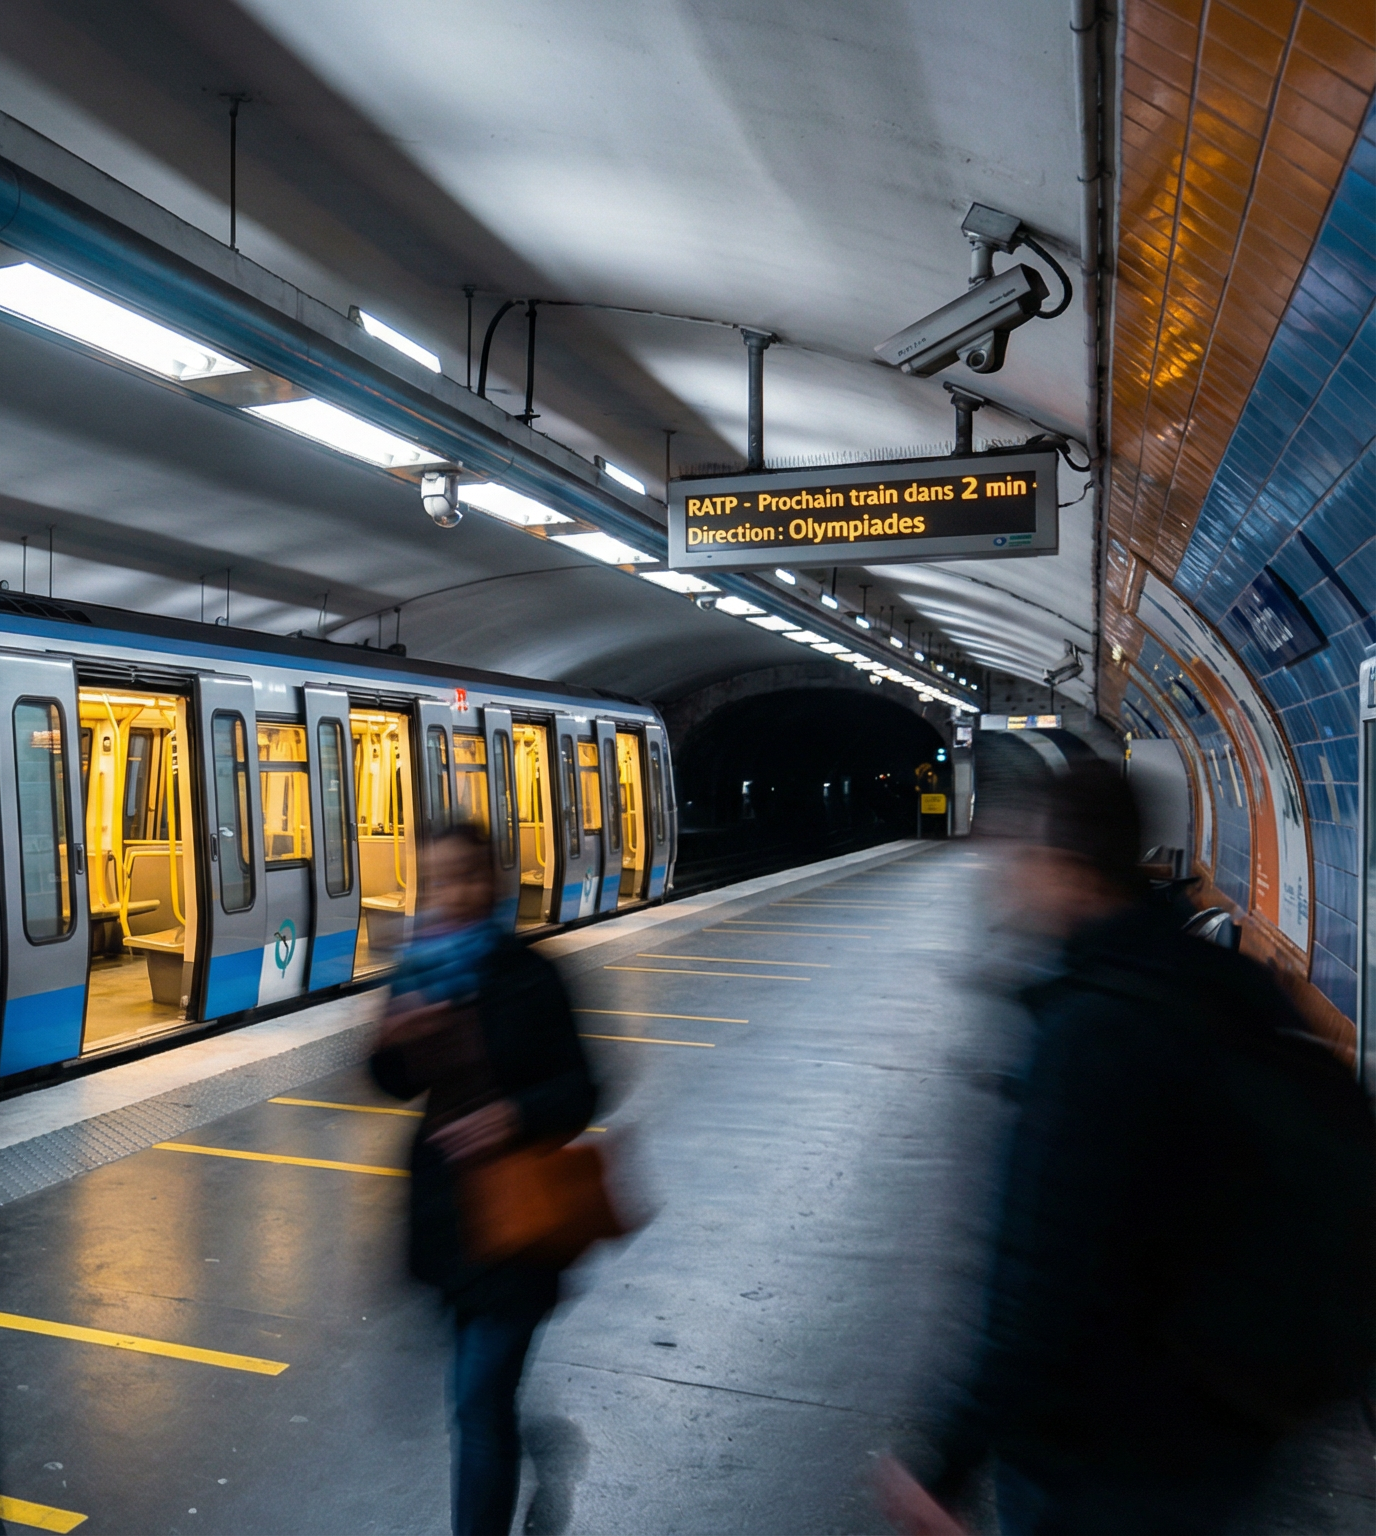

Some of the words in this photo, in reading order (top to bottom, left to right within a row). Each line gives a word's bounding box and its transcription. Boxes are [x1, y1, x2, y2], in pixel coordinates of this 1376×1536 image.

[688, 496, 738, 517] RATP
[758, 488, 844, 512] Prochain
[849, 484, 899, 506] train
[903, 482, 954, 503] dans
[961, 476, 978, 500] 2
[985, 476, 1027, 498] min
[788, 512, 926, 543] Olympiades
